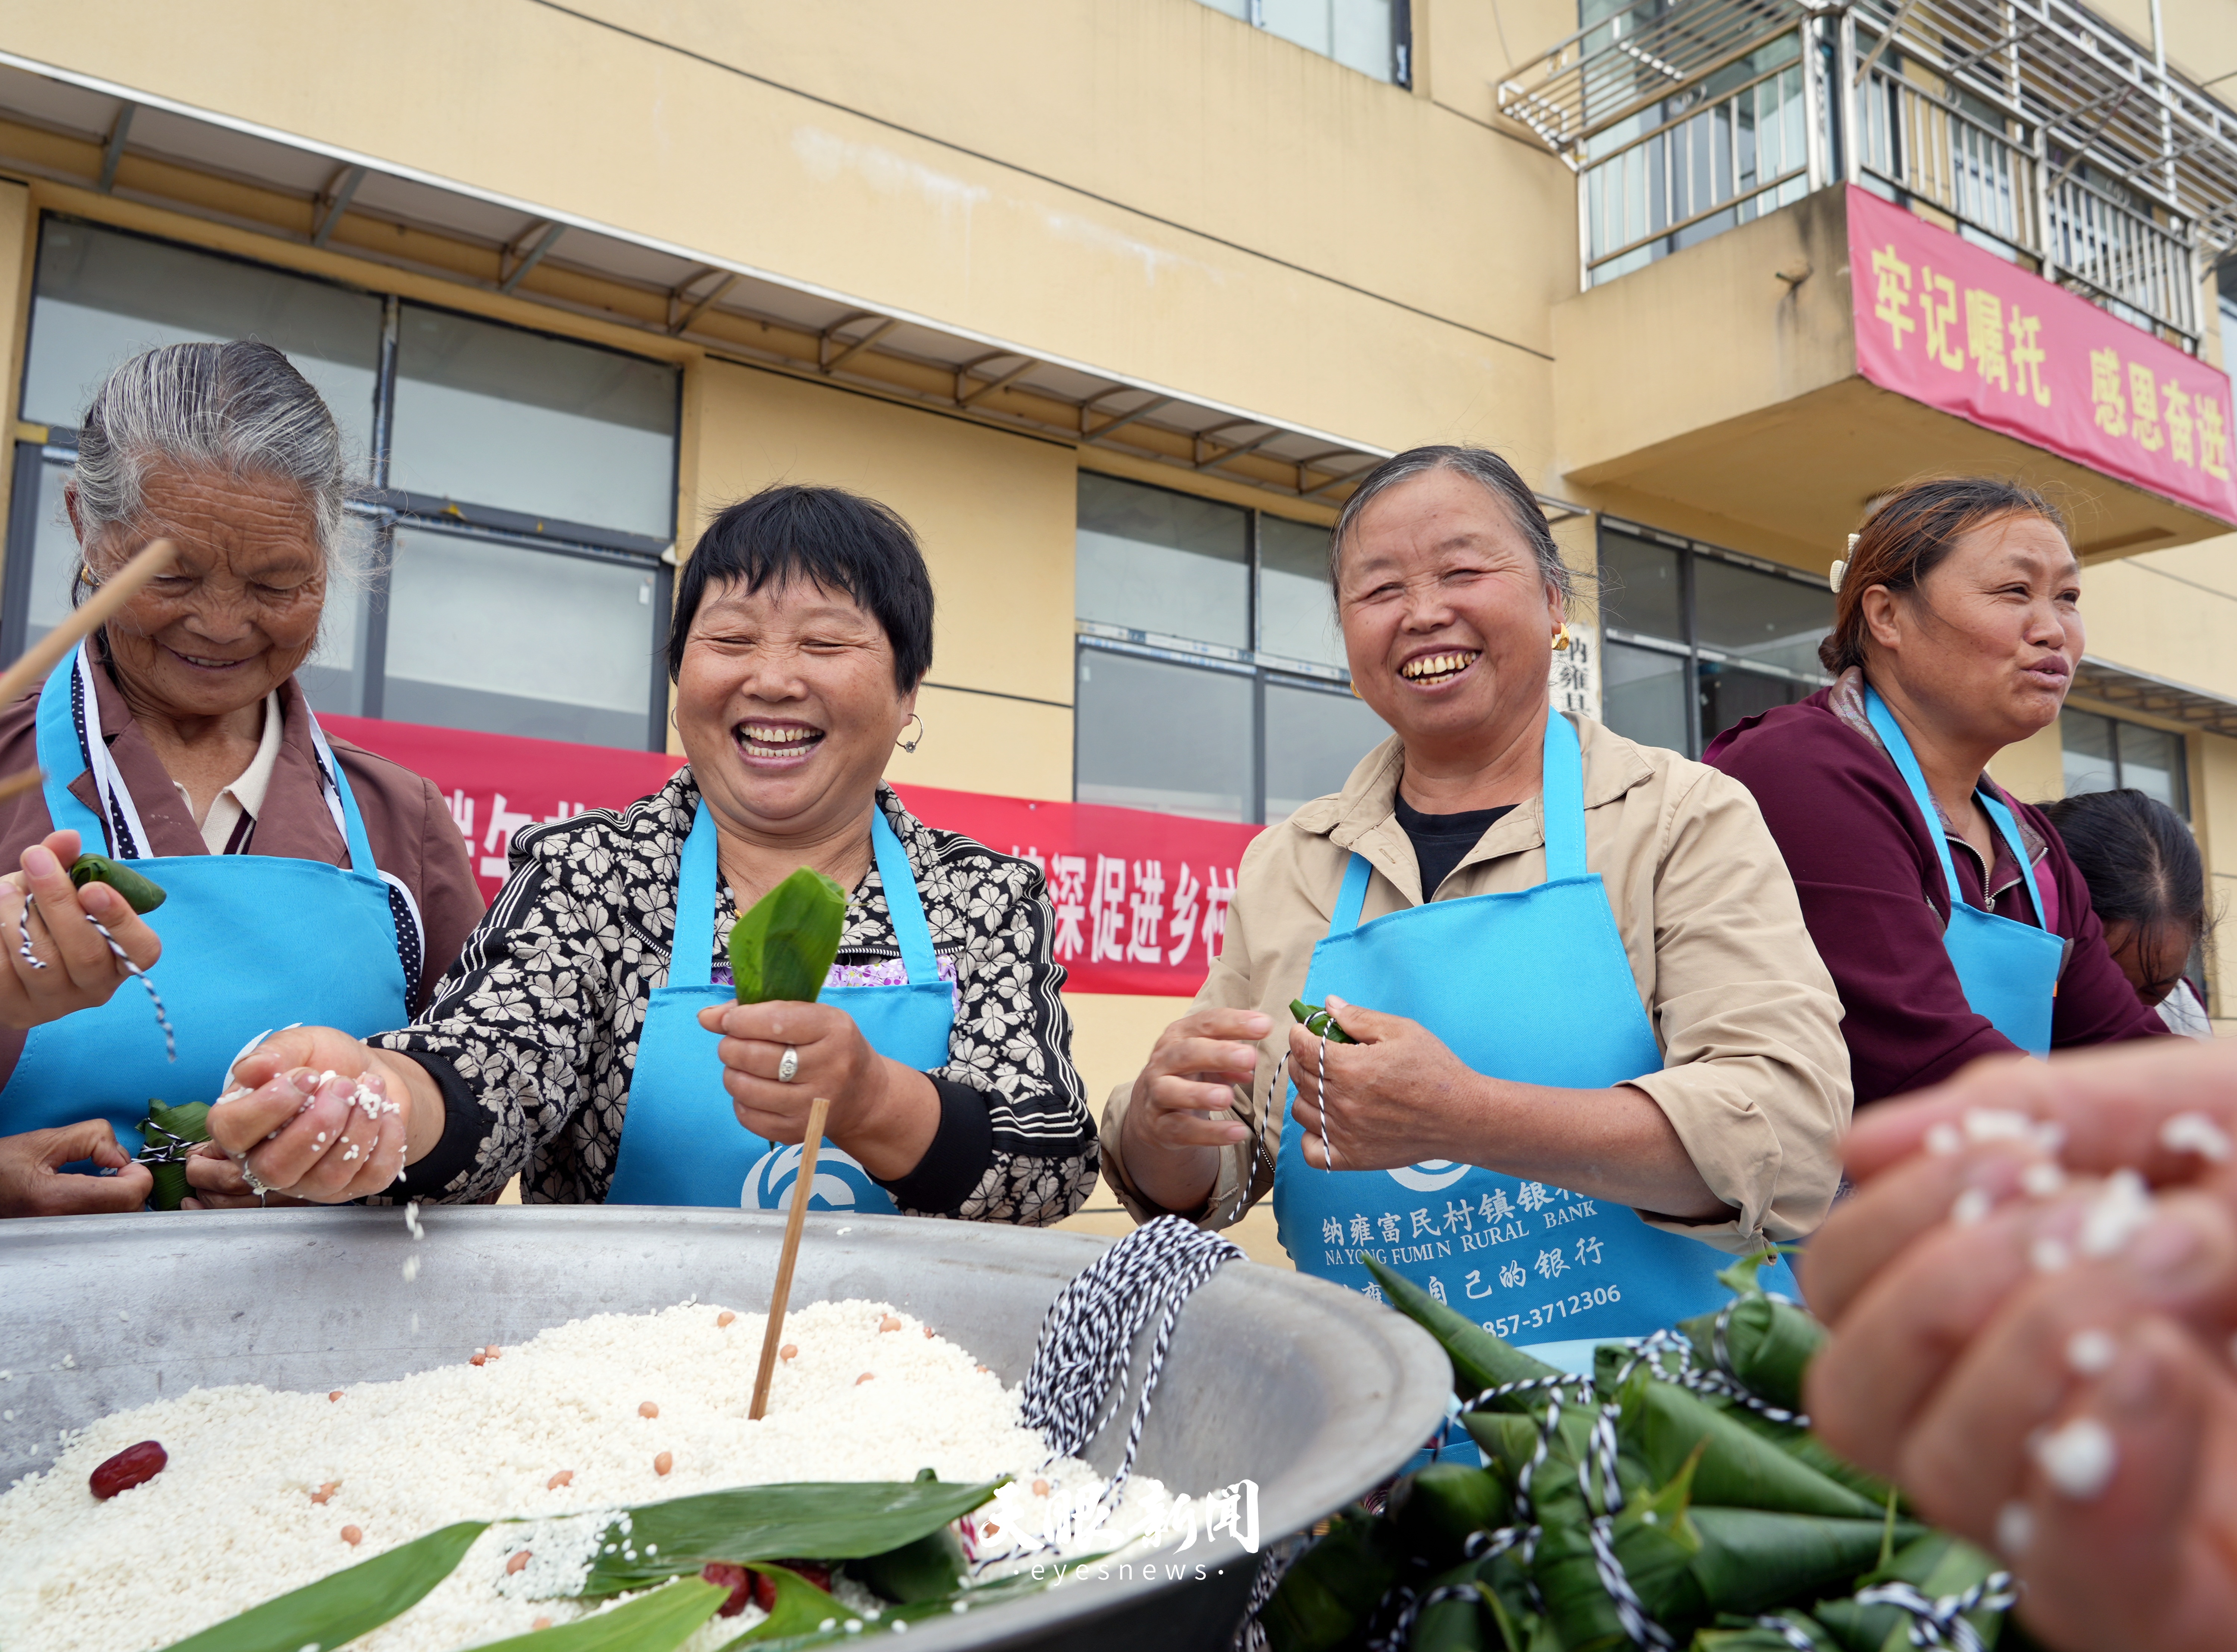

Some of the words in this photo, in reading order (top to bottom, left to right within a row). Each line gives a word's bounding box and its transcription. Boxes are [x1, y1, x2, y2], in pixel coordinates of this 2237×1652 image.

[1871, 244, 2050, 407] 牢记嘱托
[2090, 347, 2229, 481] 感恩奋进
[1460, 1220, 1529, 1252] RURAL
[1543, 1200, 1598, 1229] BANK
[1475, 1285, 1621, 1338] 857-3712306
